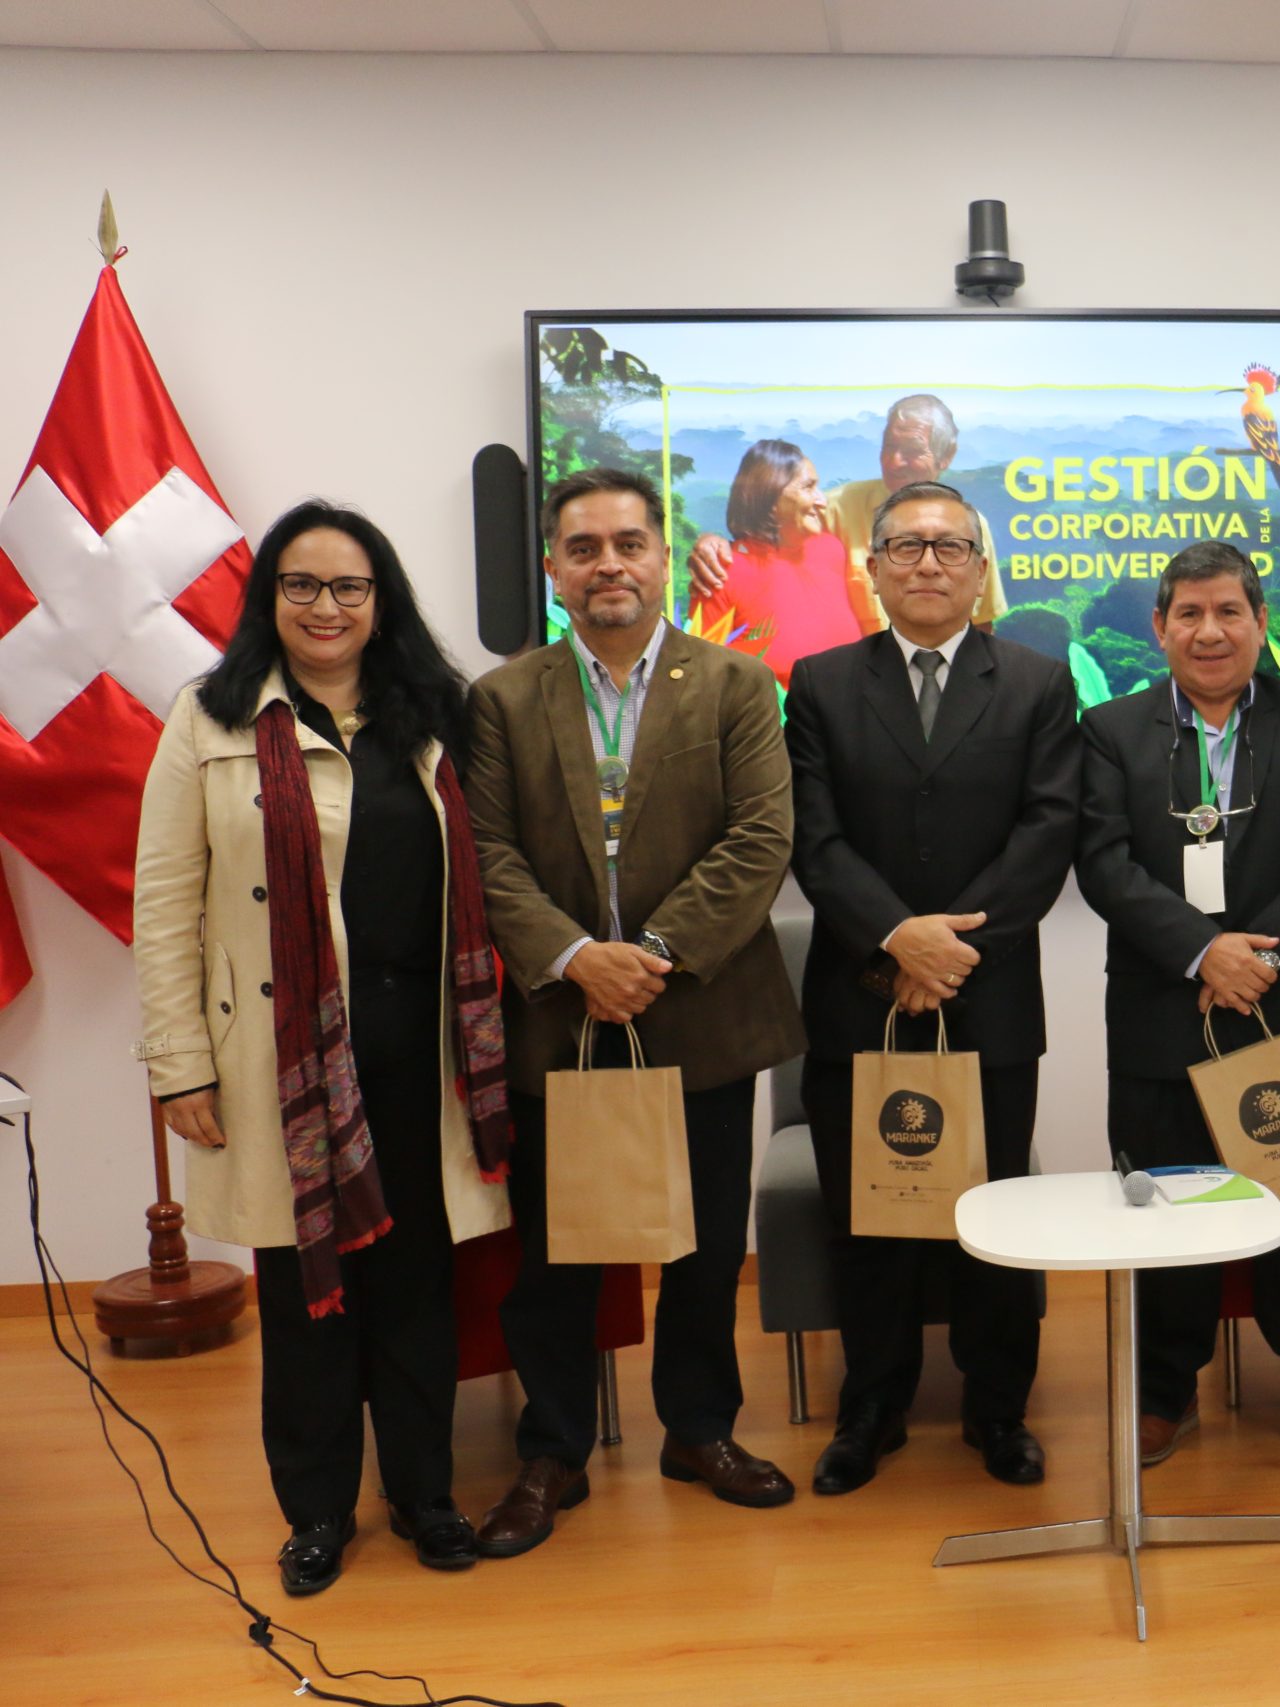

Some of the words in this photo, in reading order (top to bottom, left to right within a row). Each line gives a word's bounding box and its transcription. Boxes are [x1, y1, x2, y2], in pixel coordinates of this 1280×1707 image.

[1004, 445, 1267, 502] GESTIÓN
[1009, 512, 1248, 540] CORPORATIVA
[1260, 507, 1271, 523] LA
[1260, 526, 1271, 543] DE
[1011, 551, 1273, 580] BIODIVERD
[885, 1132, 937, 1144] MARANKE
